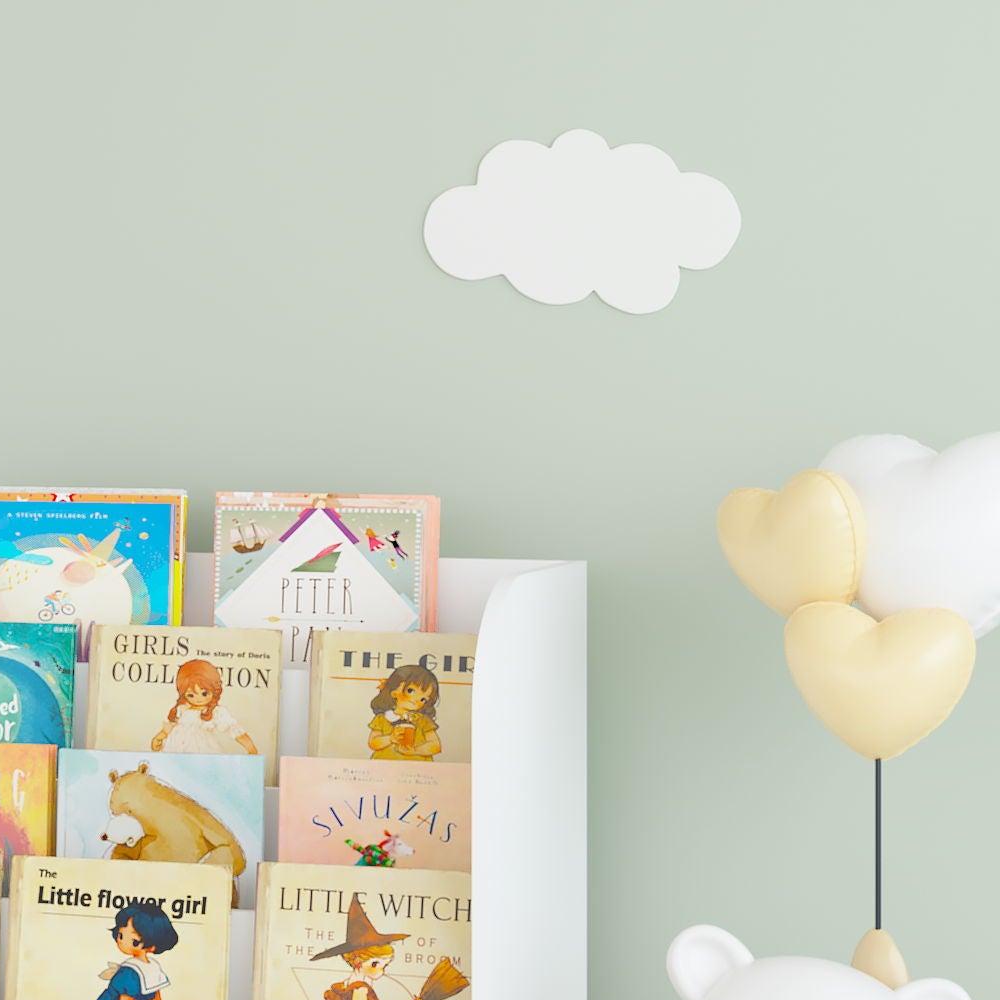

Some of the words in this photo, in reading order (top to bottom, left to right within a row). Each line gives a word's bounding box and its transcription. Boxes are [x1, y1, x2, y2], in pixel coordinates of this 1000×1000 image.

[282, 577, 353, 615] PETER
[114, 633, 190, 656] GIRLS
[213, 651, 234, 659] story
[111, 660, 273, 689] COLLION
[312, 795, 457, 843] SIVUŽAS
[39, 868, 57, 879] The
[37, 885, 92, 908] Little
[171, 895, 208, 919] girl
[378, 893, 471, 922] WITCH
[304, 927, 335, 941] THE
[416, 936, 438, 948] OF
[404, 952, 462, 966] BROM
